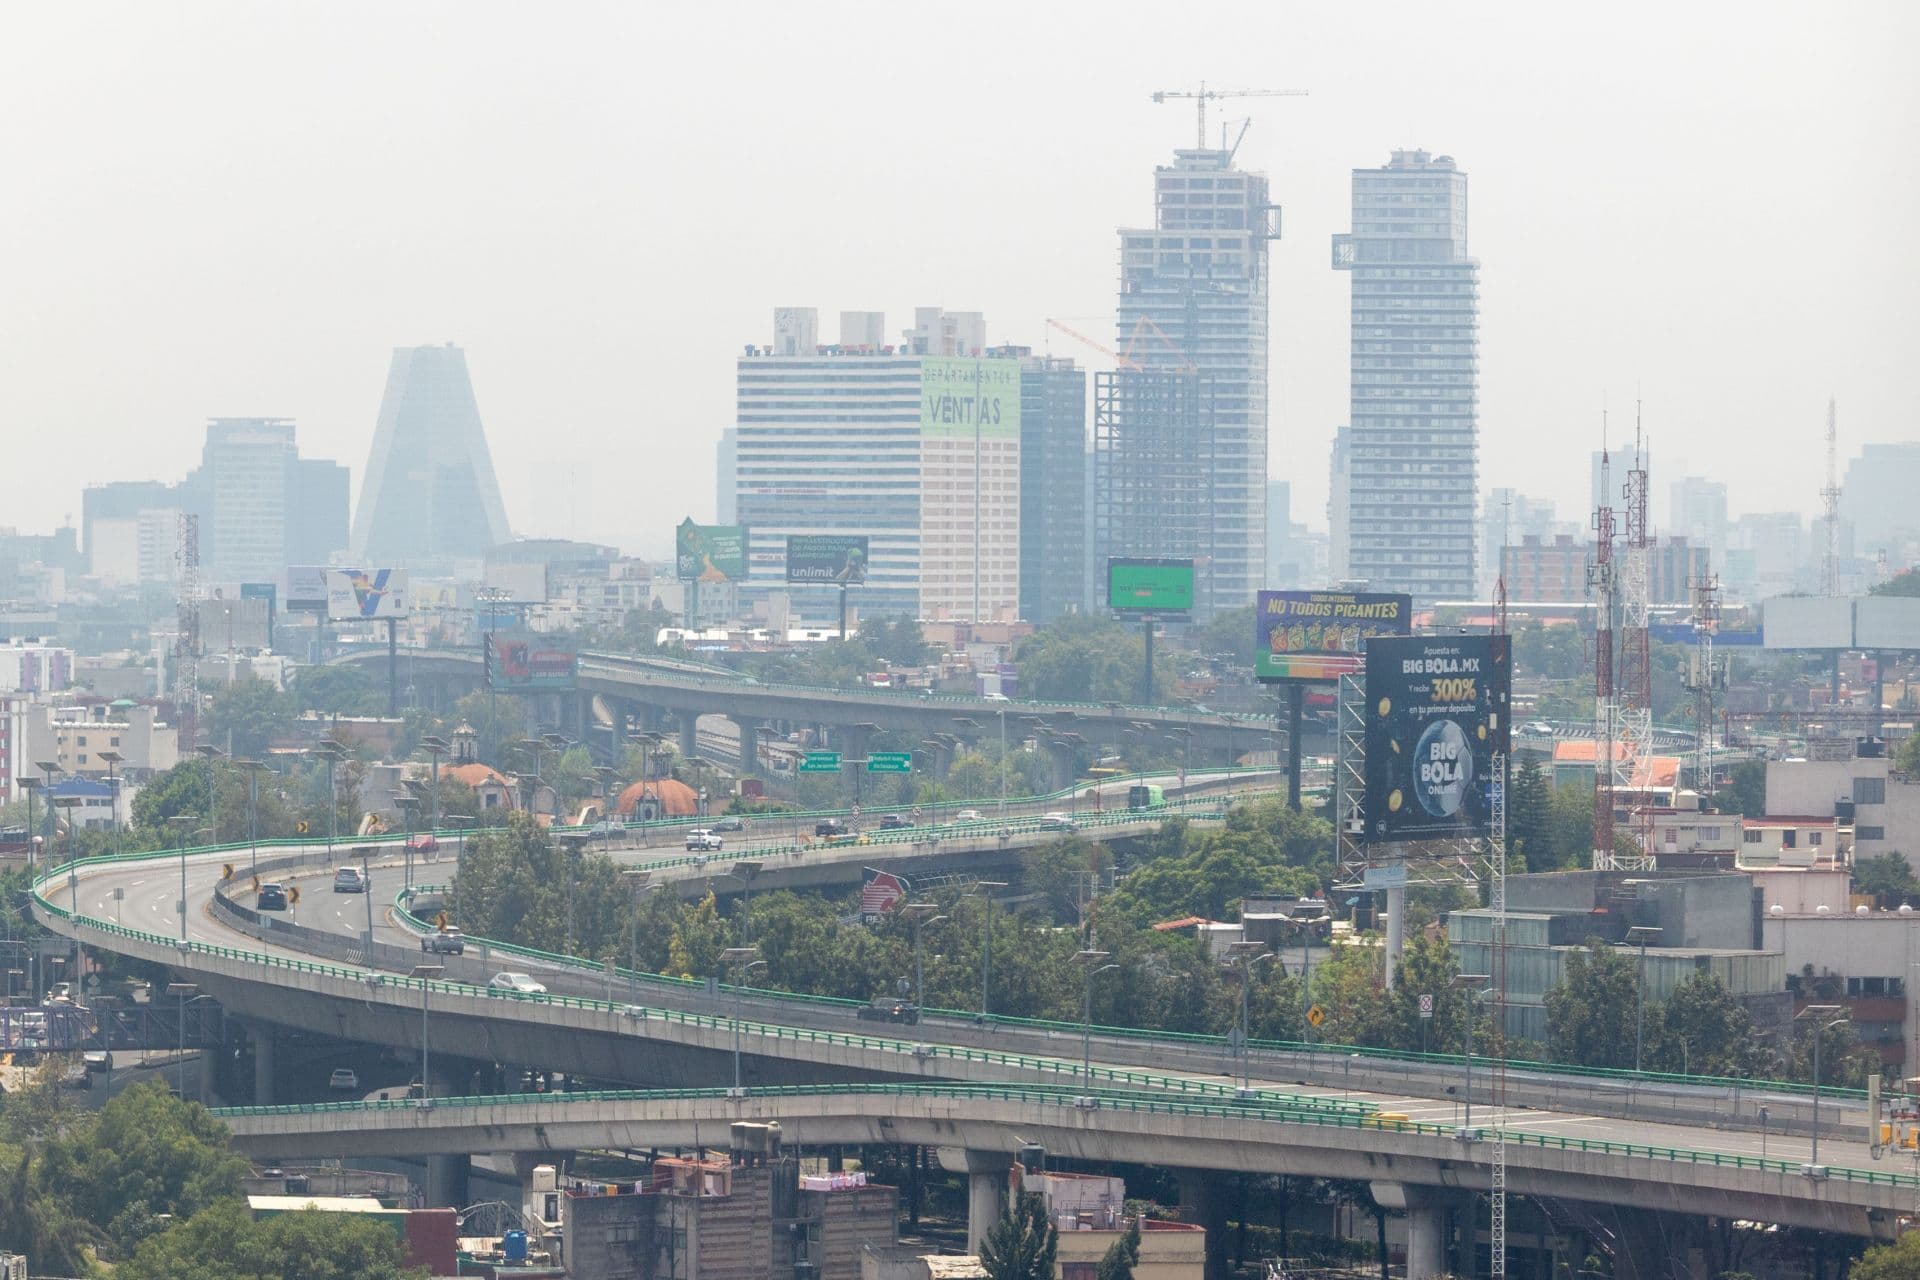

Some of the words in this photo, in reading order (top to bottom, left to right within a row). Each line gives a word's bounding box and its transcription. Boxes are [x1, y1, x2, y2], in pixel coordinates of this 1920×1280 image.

[925, 368, 1010, 384] DEPARTAMENTOS
[929, 395, 1001, 425] VENTAS
[791, 565, 834, 578] unlimit
[1268, 598, 1286, 614] NO
[1289, 601, 1331, 617] TODOS
[1334, 602, 1399, 619] PICANTES
[1424, 646, 1449, 656] Apuesta
[1402, 659, 1423, 674] BIG
[1425, 658, 1480, 674] BOLA.MX
[1430, 678, 1477, 701] 300%
[1409, 706, 1418, 714] en
[1418, 704, 1426, 714] tu
[1427, 705, 1448, 716] primer
[1449, 704, 1476, 715] depósito
[1430, 742, 1457, 760] BIG
[1421, 761, 1464, 781] BOLA
[1428, 786, 1457, 795] ONLINE
